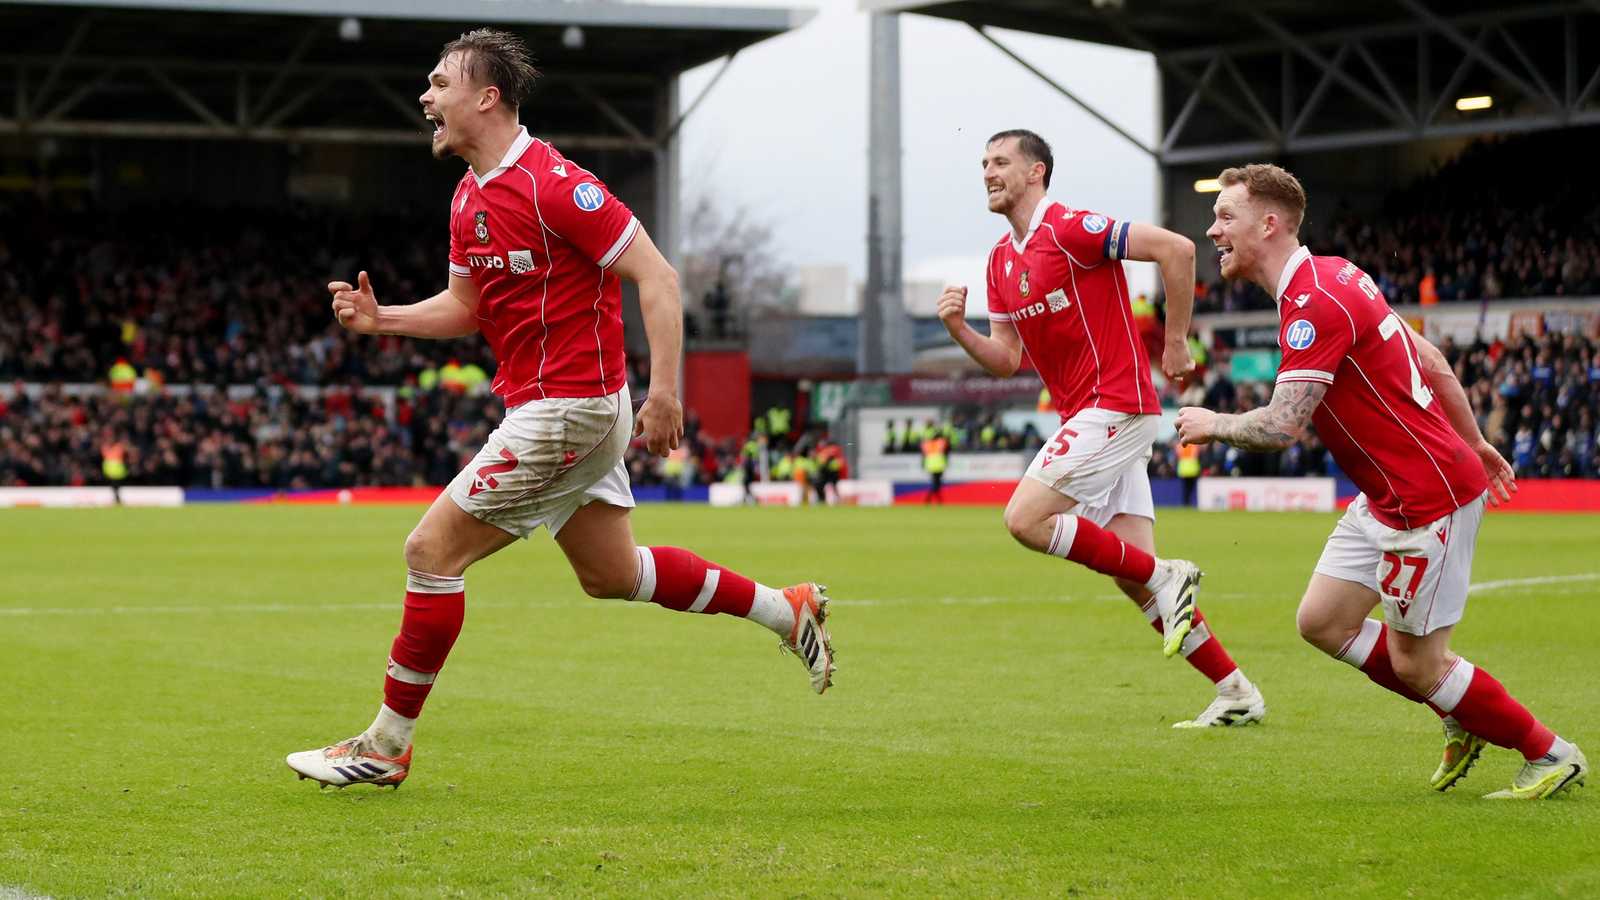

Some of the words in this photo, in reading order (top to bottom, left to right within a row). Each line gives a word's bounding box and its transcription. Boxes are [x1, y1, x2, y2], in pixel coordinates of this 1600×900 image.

[575, 184, 602, 209] hp
[1009, 302, 1045, 321] NITED
[1289, 321, 1312, 348] hp
[1378, 313, 1433, 409] 2
[1046, 427, 1079, 456] 5
[476, 448, 519, 489] 2
[1381, 551, 1429, 600] 27
